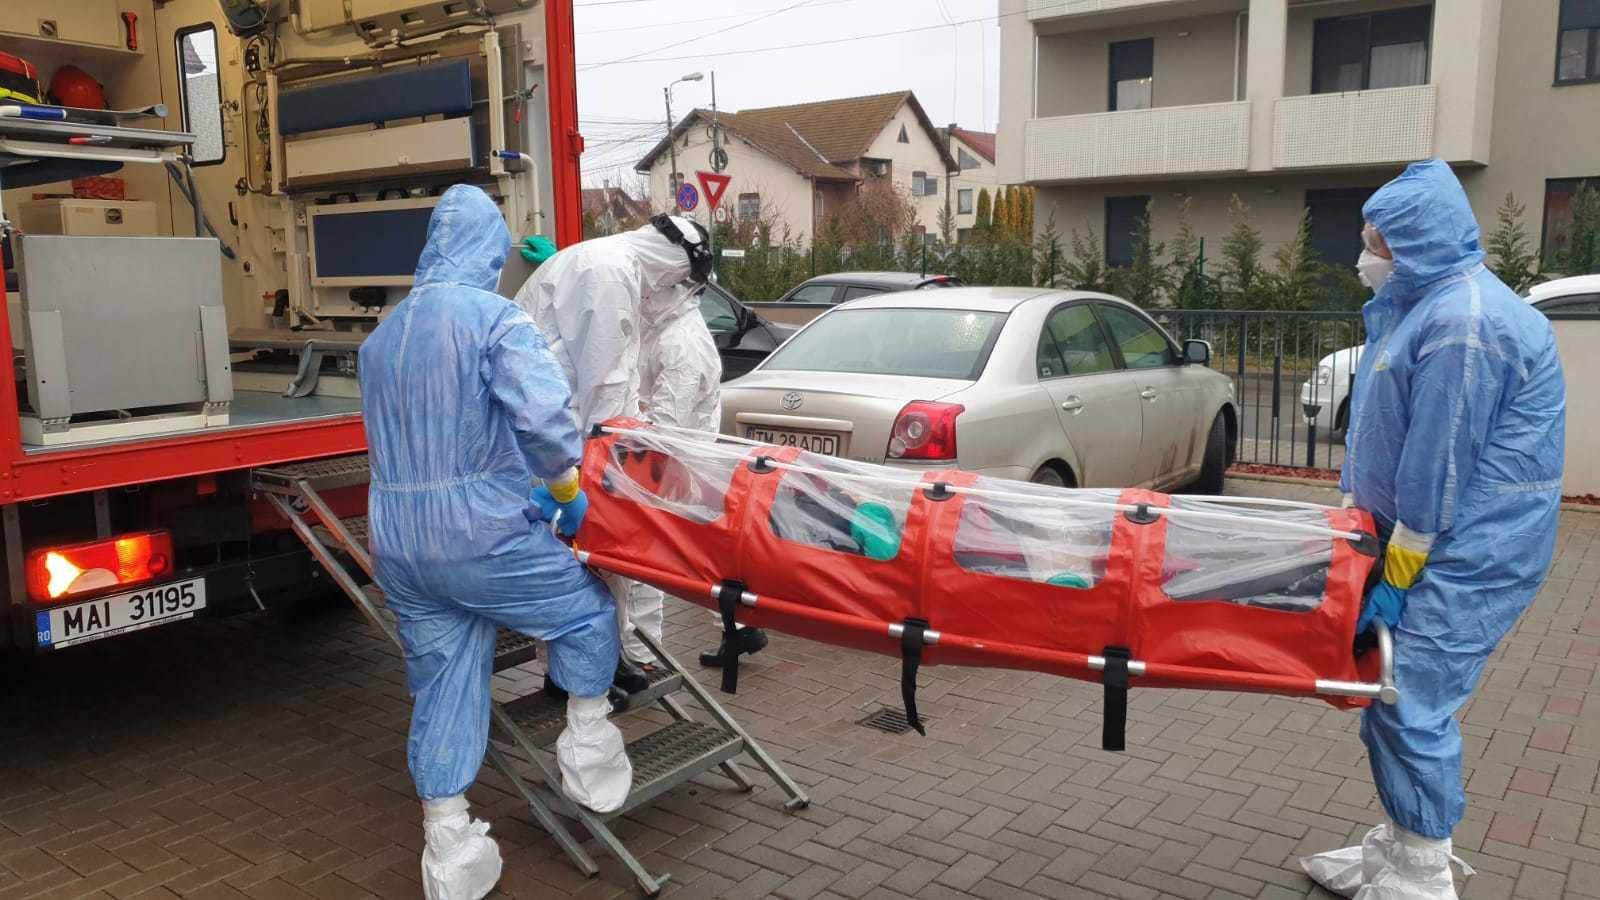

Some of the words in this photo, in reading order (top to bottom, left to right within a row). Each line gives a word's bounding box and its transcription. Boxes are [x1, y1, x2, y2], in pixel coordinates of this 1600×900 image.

[800, 436, 835, 455] ADD
[63, 601, 111, 637] MAI
[128, 583, 196, 621] 31195
[37, 630, 50, 642] RO
